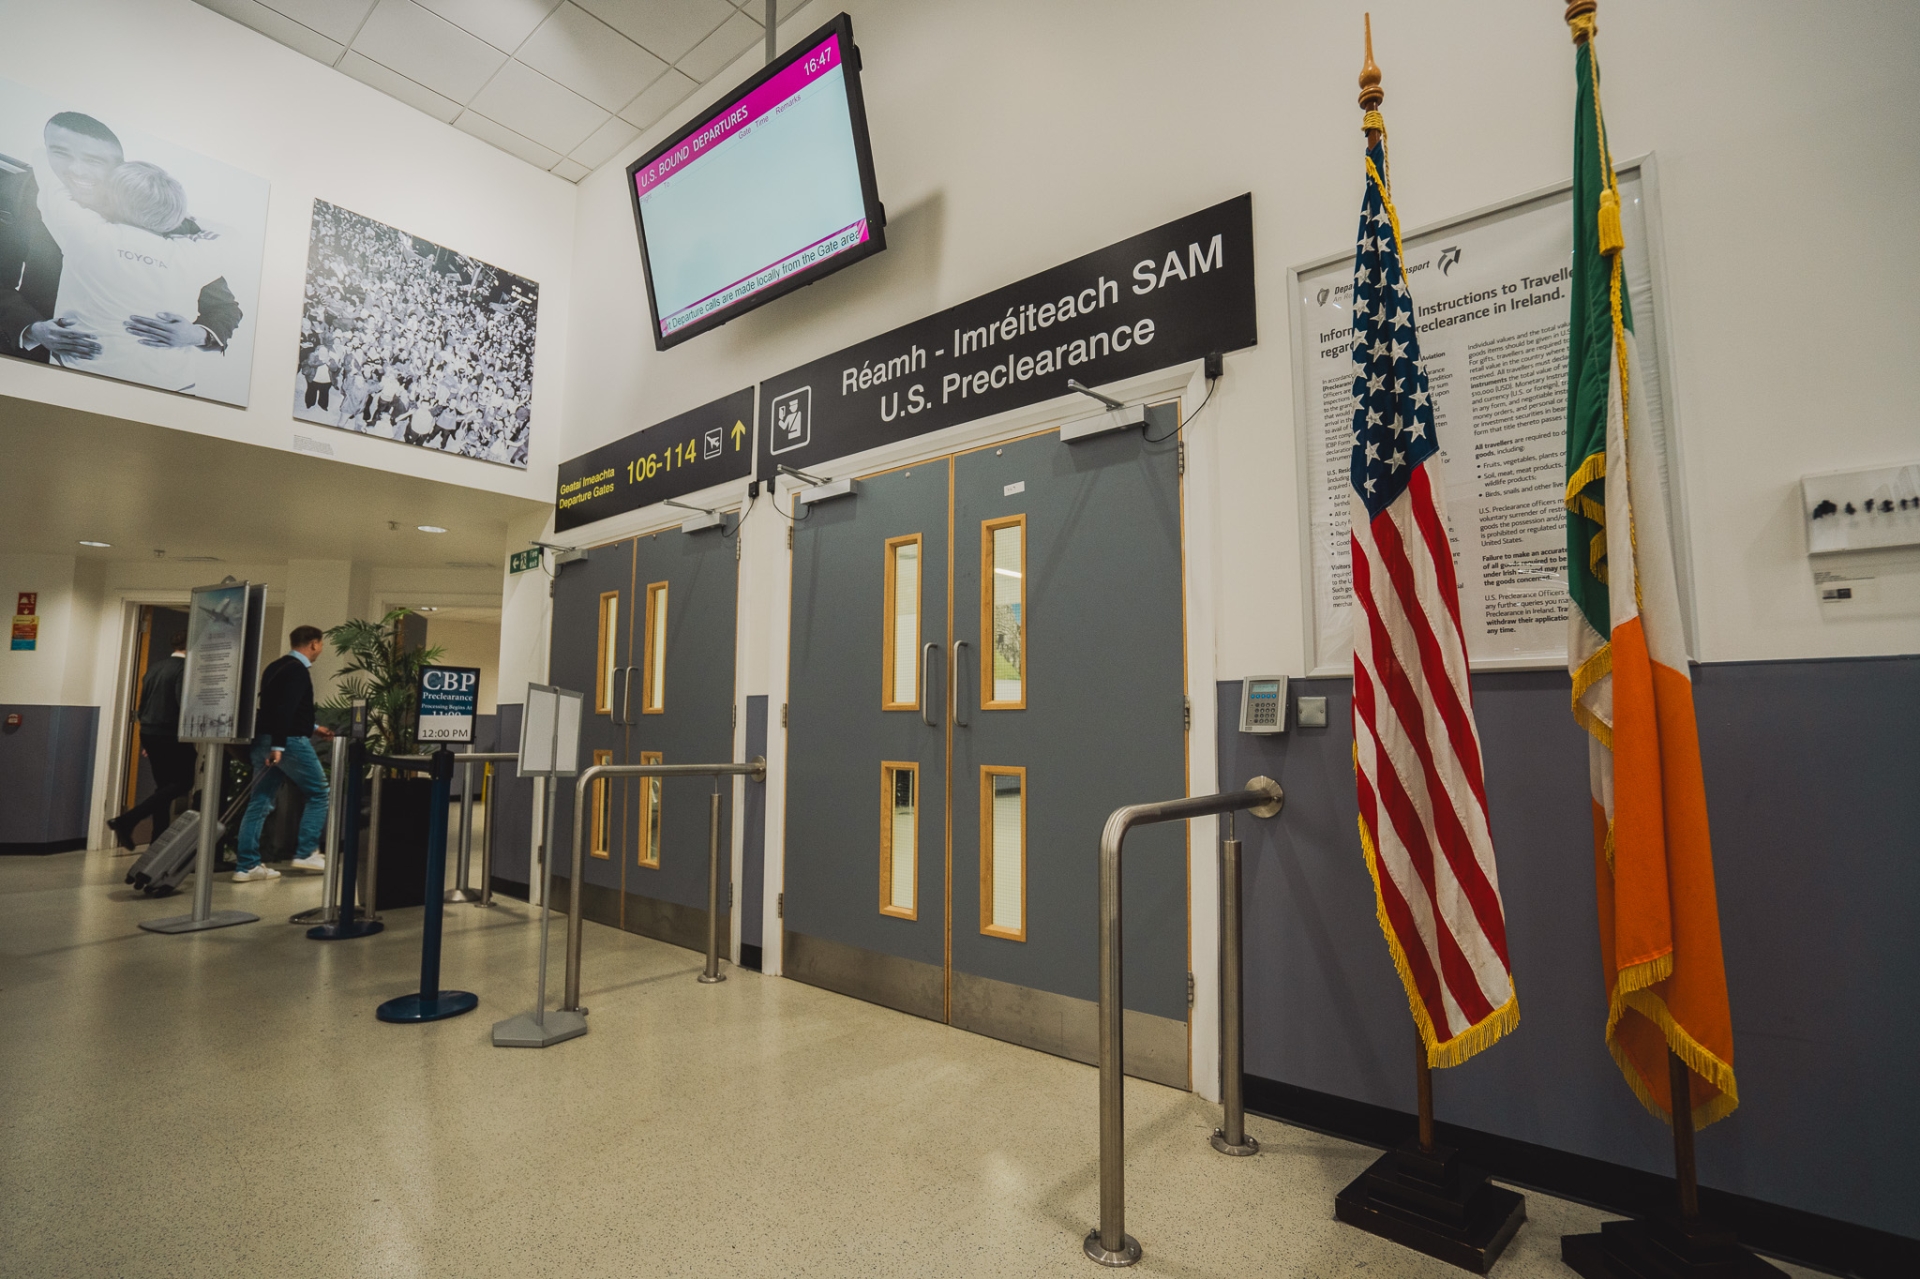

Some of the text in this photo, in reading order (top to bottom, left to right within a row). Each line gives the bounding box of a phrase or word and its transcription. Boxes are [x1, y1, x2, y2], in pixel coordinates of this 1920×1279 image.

[803, 46, 832, 76] 16:47
[738, 127, 752, 140] Gate
[755, 115, 769, 128] Time
[775, 94, 801, 115] Remarks
[641, 105, 748, 187] U.S. BOUND DEPARTURES
[117, 249, 168, 270] TOYOTA
[672, 306, 704, 329] Departure
[705, 298, 720, 312] calls
[722, 292, 734, 306] are
[734, 281, 755, 298] made
[756, 269, 781, 287] locally
[782, 258, 800, 276] from
[801, 251, 816, 266] the
[817, 240, 839, 257] Gate
[1417, 285, 1498, 318] Instructions
[1502, 281, 1517, 295] to
[1494, 302, 1507, 314] in
[1510, 286, 1565, 311] Ireland.
[842, 345, 926, 397] Réamh
[954, 276, 1118, 358] Imréiteach
[1131, 233, 1224, 295] SAM
[1468, 339, 1495, 351] Individual
[1517, 331, 1528, 339] and
[1541, 324, 1555, 333] total
[1521, 353, 1544, 362] country
[1546, 348, 1565, 356] where
[880, 318, 1155, 423] U.S. Preclearance
[1541, 415, 1562, 425] passes
[1485, 440, 1513, 449] travellers
[1526, 431, 1551, 442] required
[627, 438, 697, 485] 106-114
[1504, 455, 1537, 466] vegetables,
[1539, 451, 1558, 461] plants
[1498, 469, 1514, 477] meat,
[1516, 466, 1531, 474] meat
[1534, 462, 1563, 473] products,
[560, 467, 615, 496] Geataí Imeachta
[1485, 479, 1506, 487] wildlife
[559, 482, 614, 509] Departure Gates
[1503, 487, 1520, 495] snails
[1492, 504, 1530, 513] Preclearance
[1509, 510, 1538, 518] surrender
[1480, 523, 1498, 532] goods
[1512, 517, 1545, 528] possession
[1487, 528, 1518, 539] prohibited
[1527, 523, 1557, 533] regulated
[1481, 538, 1501, 546] United
[1496, 578, 1515, 587] goods
[1521, 599, 1543, 608] queries
[1533, 606, 1555, 614] Ireland.
[1535, 614, 1568, 624] applicatio
[423, 670, 476, 692] CBP
[422, 692, 473, 701] Preclearance
[422, 729, 468, 738] 12:00 PM
